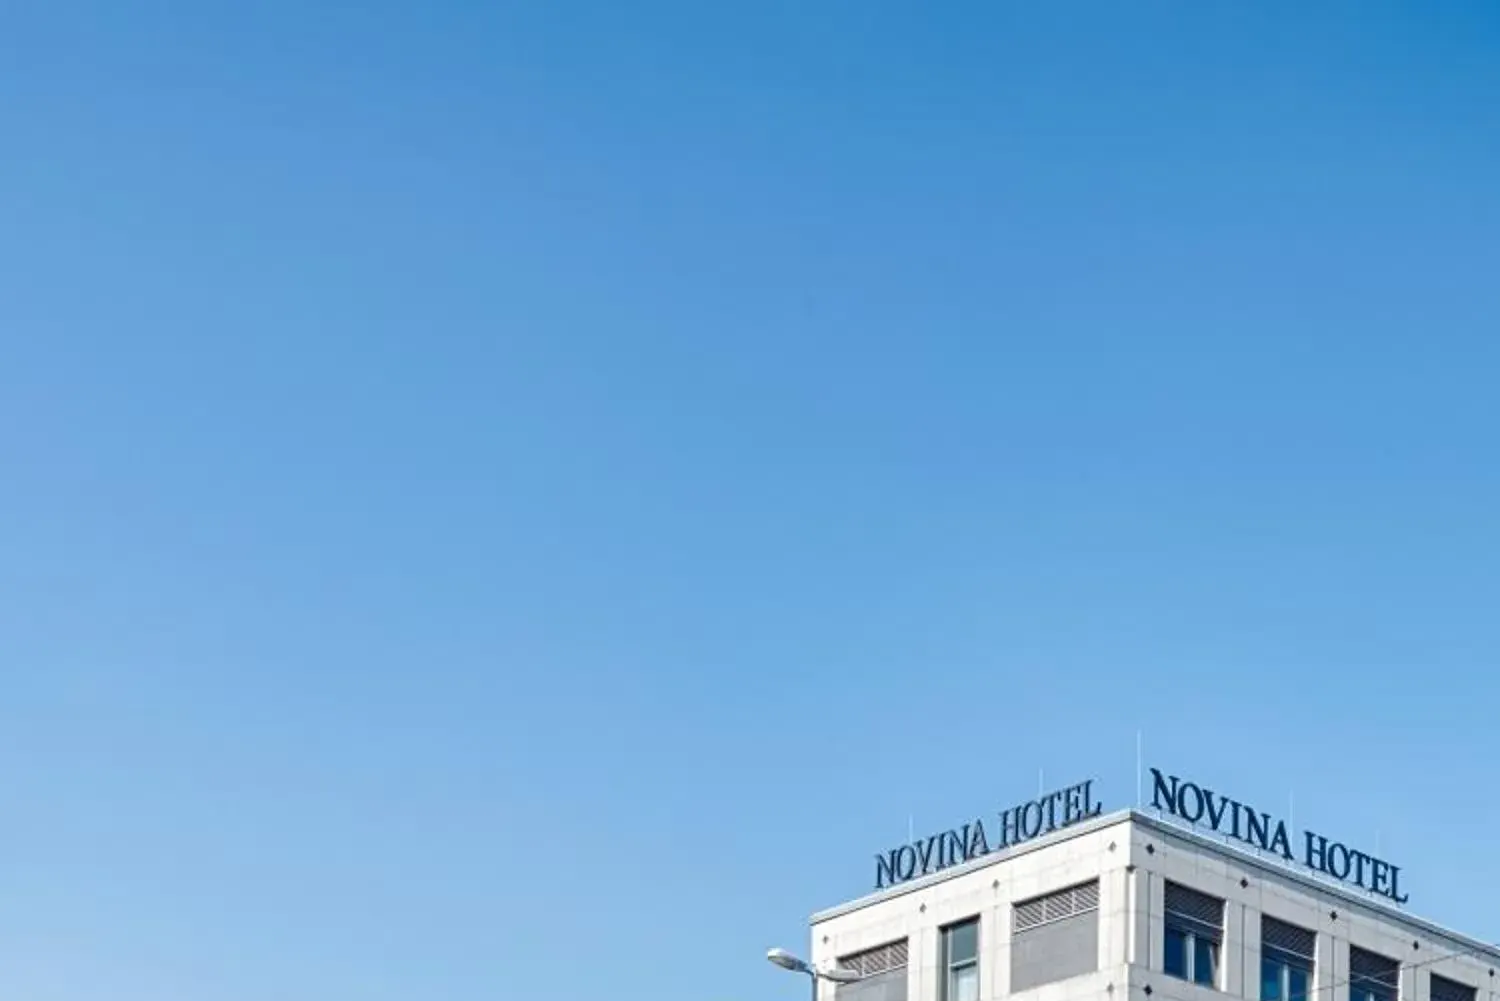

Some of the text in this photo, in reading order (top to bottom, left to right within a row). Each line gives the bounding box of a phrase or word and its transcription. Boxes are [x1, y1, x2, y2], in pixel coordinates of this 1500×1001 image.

[874, 778, 1102, 888] NOVINA HOTEL
[1149, 767, 1409, 904] NOVINA HOTEL
